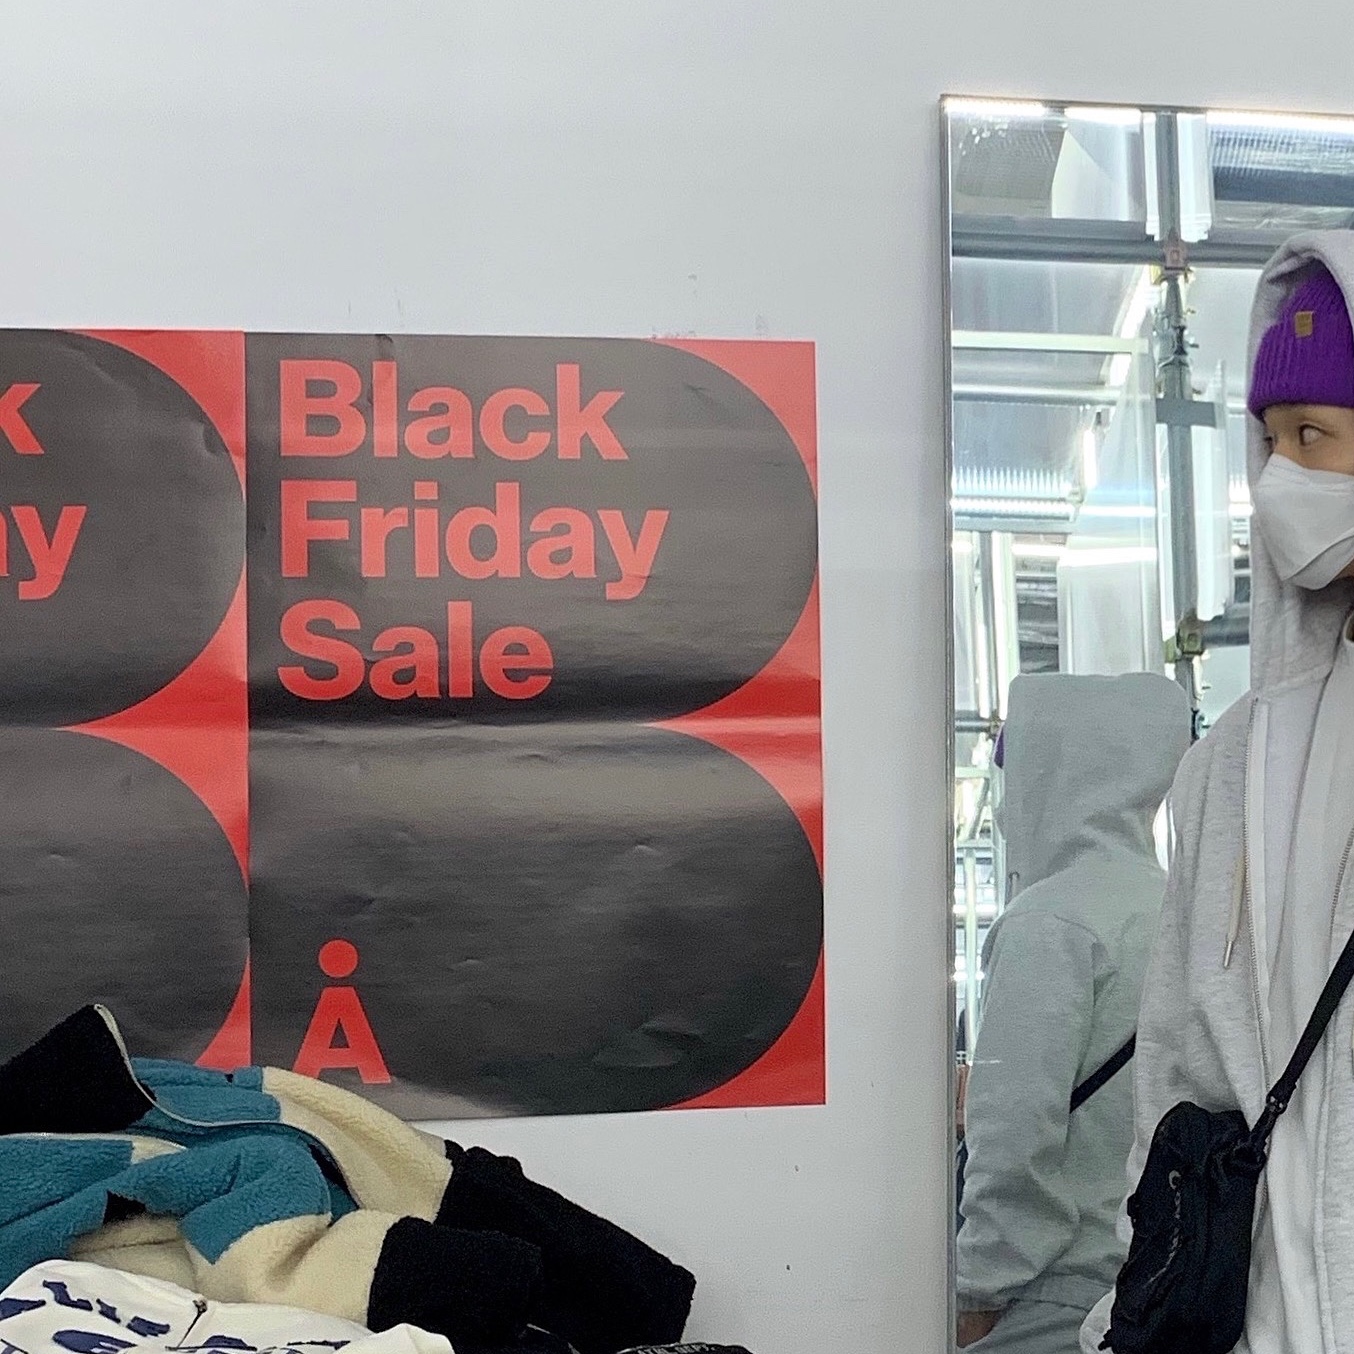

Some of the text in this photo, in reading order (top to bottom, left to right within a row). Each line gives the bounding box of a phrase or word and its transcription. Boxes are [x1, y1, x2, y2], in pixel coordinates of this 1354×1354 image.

[279, 360, 628, 460] Black
[279, 480, 669, 600] Friday
[278, 599, 554, 702] Sale
